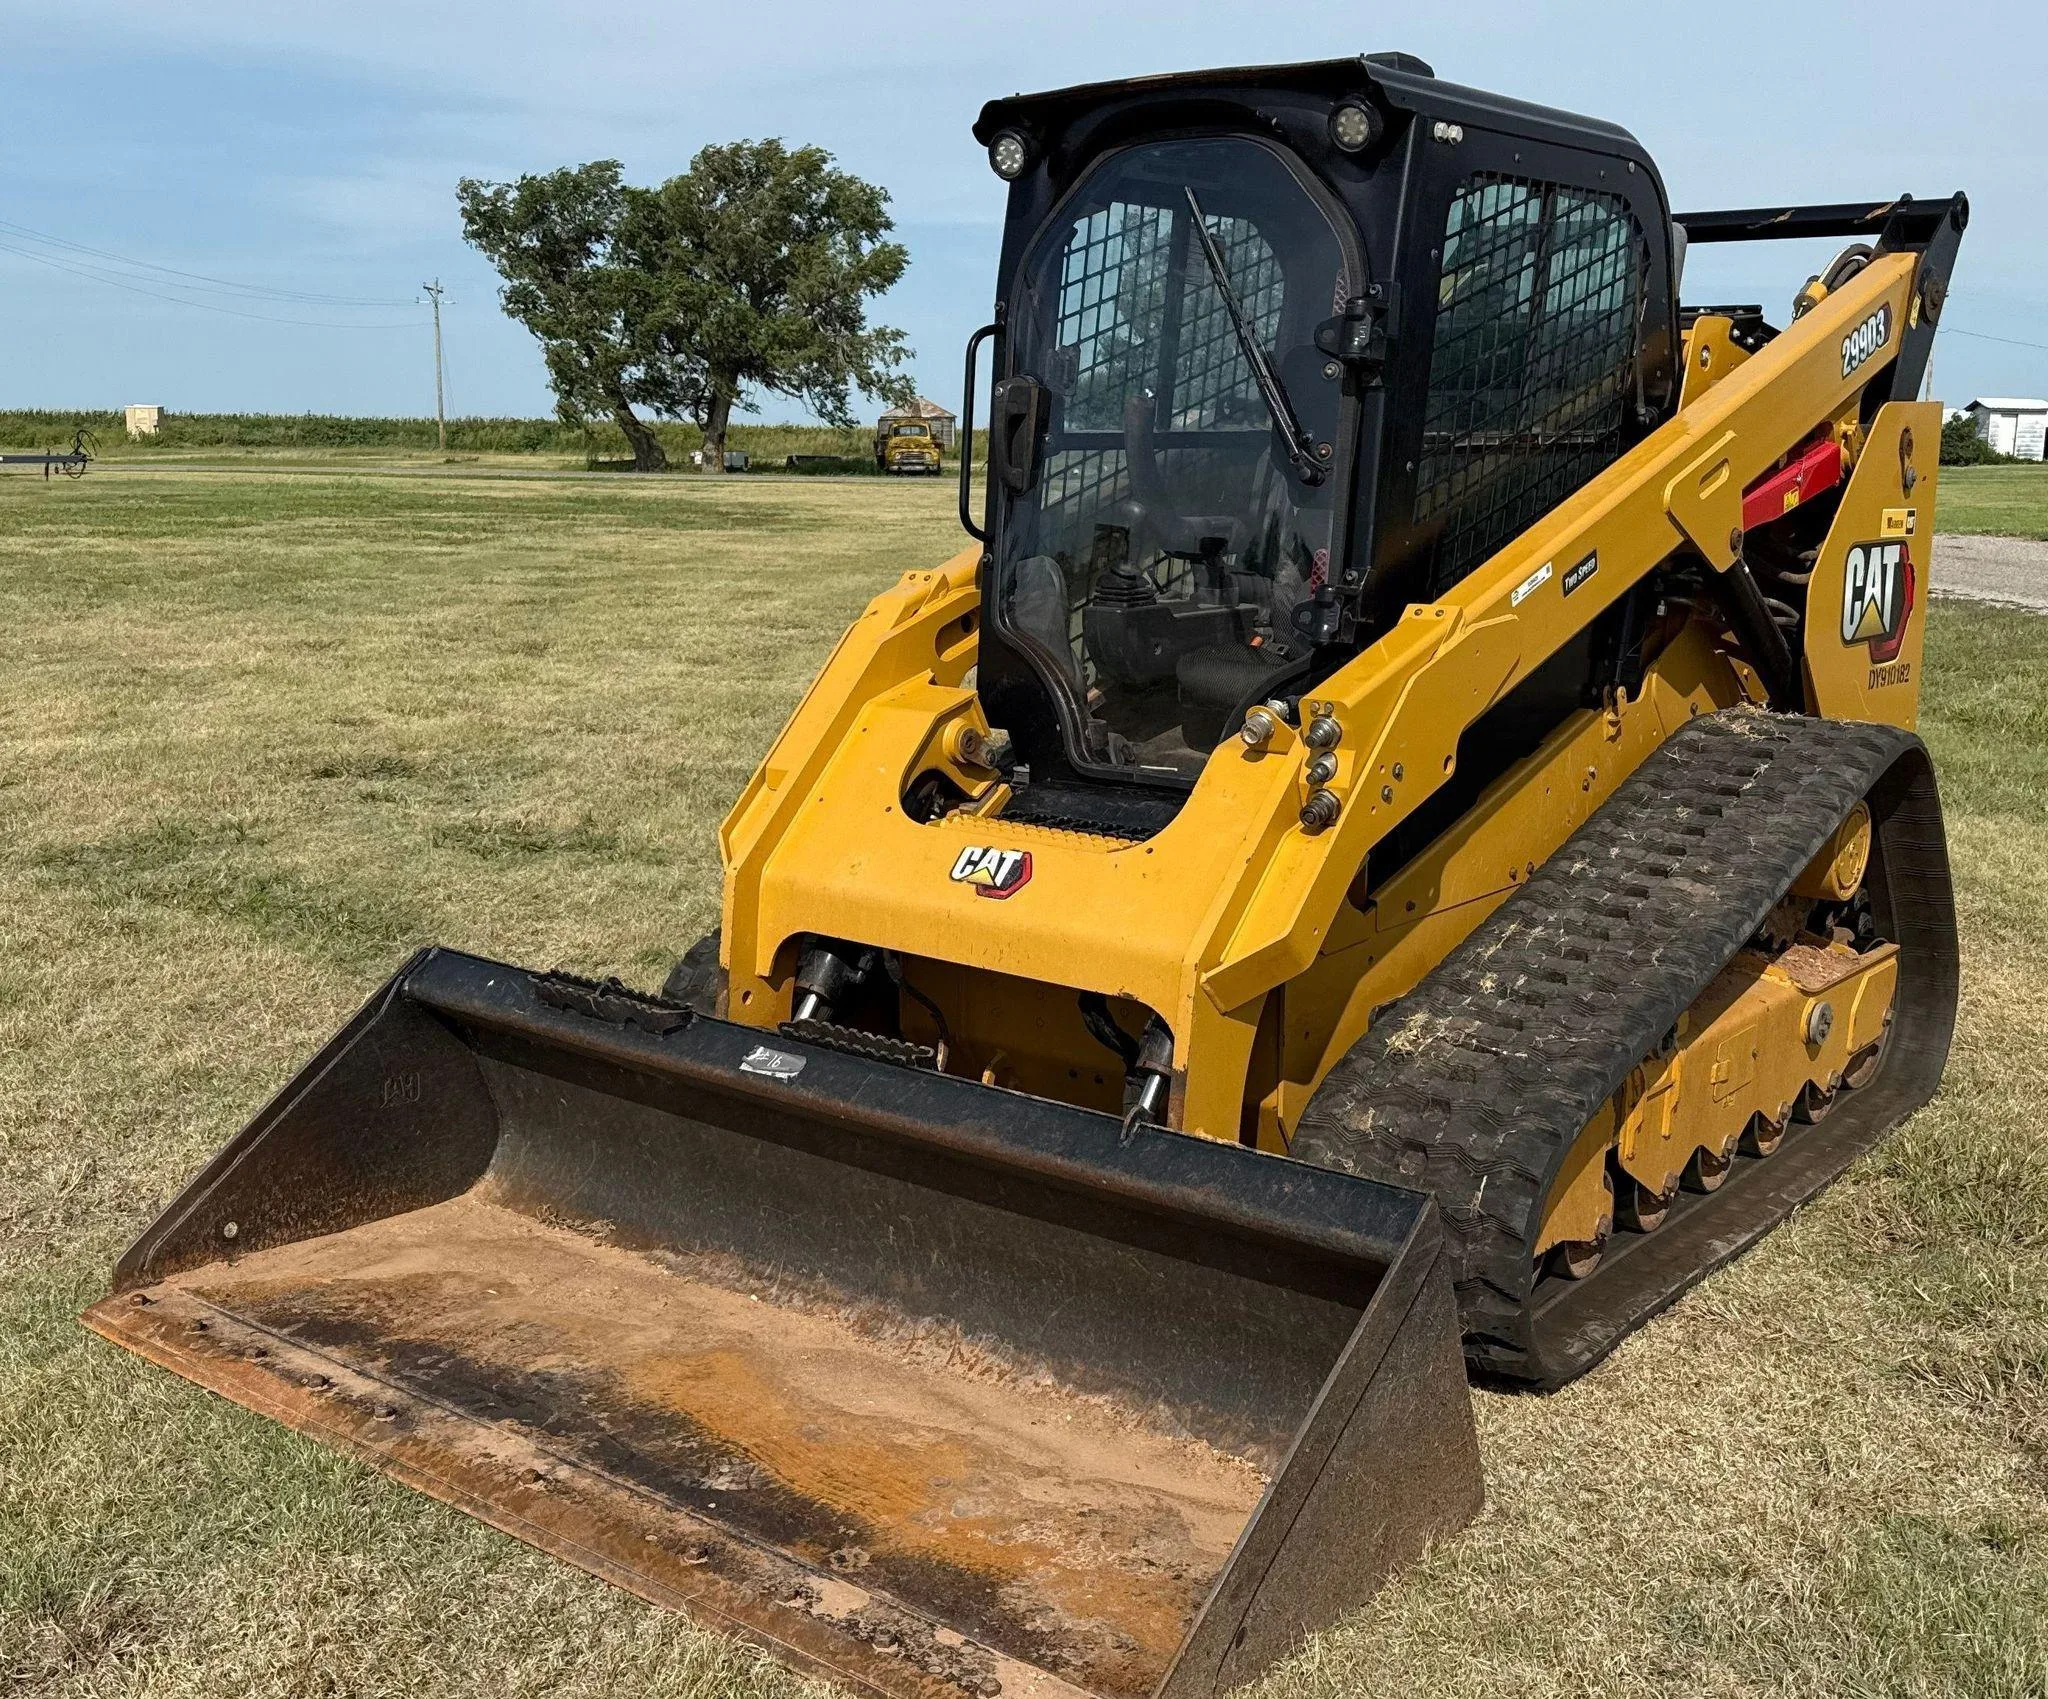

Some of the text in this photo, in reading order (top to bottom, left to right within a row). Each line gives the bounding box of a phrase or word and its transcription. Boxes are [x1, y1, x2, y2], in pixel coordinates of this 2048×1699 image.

[1841, 308, 1886, 377] 299D3
[1842, 545, 1900, 640] CAT
[951, 846, 1024, 887] CAT
